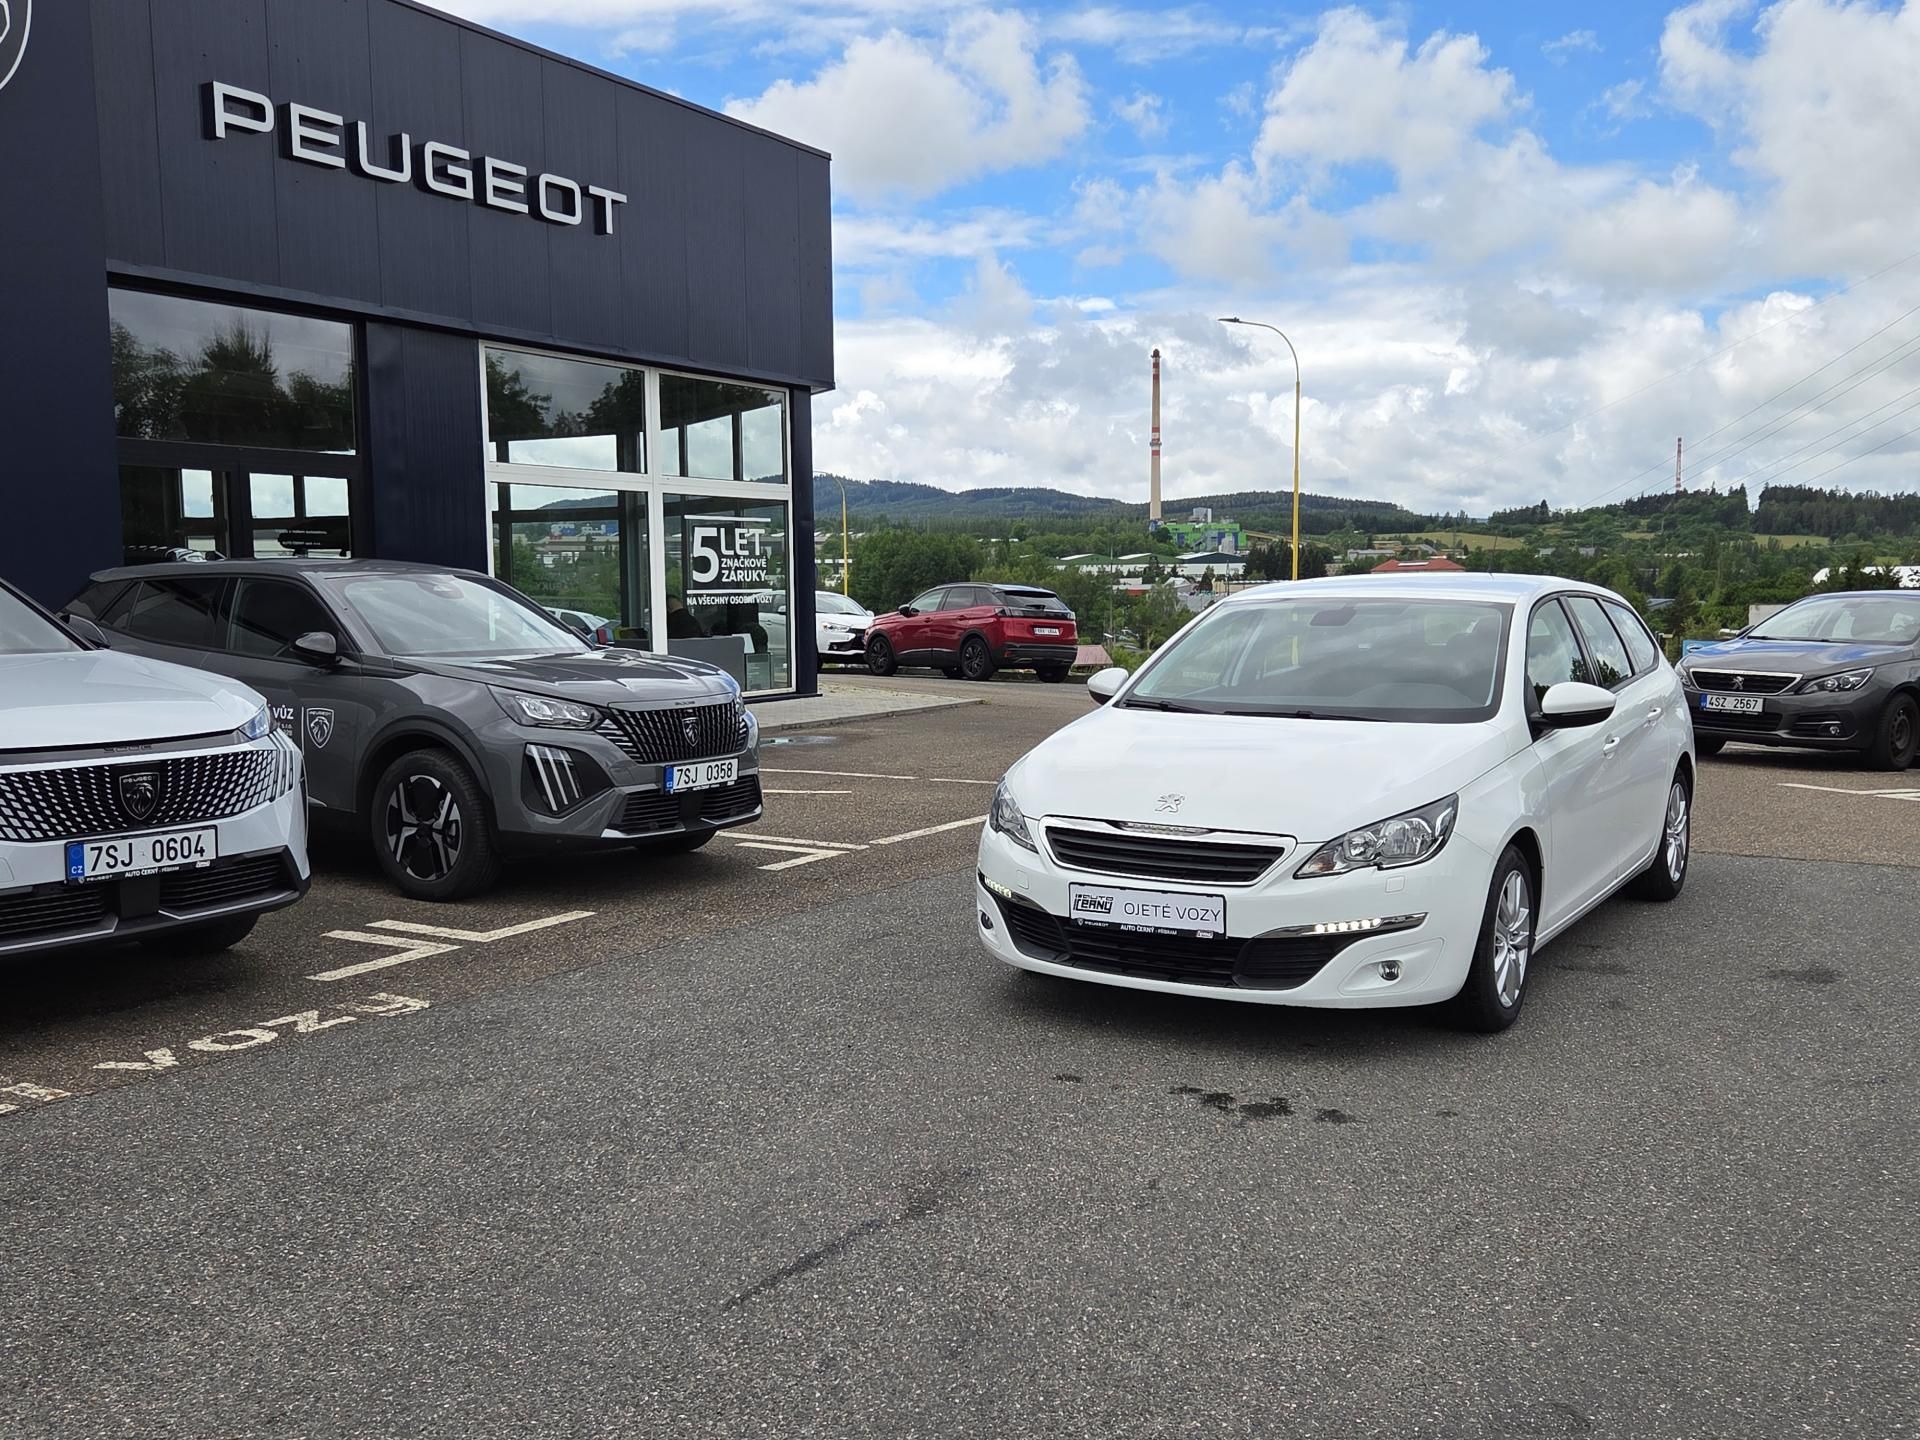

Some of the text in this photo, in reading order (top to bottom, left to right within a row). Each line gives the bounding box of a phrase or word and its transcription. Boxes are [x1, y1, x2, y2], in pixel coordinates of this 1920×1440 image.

[210, 80, 628, 236] PEUGEOT
[692, 526, 766, 583] 5 LET
[720, 555, 768, 568] ZNAČKOVÉ
[721, 564, 767, 582] ZÁRUKY
[686, 596, 698, 606] NA
[698, 594, 729, 606] VŠECHNY
[1708, 696, 1727, 708] 4SZ
[1733, 698, 1758, 710] 2567
[272, 704, 294, 719] VŮZ
[676, 761, 733, 786] 7SJ 0358
[90, 833, 206, 871] 7SJ 0604
[71, 865, 83, 874] CZ
[124, 870, 141, 878] AUTO
[140, 866, 159, 877] ČERNÝ
[1124, 901, 1221, 922] OJETÉ VOZY
[1136, 924, 1155, 934] ČERNÝ
